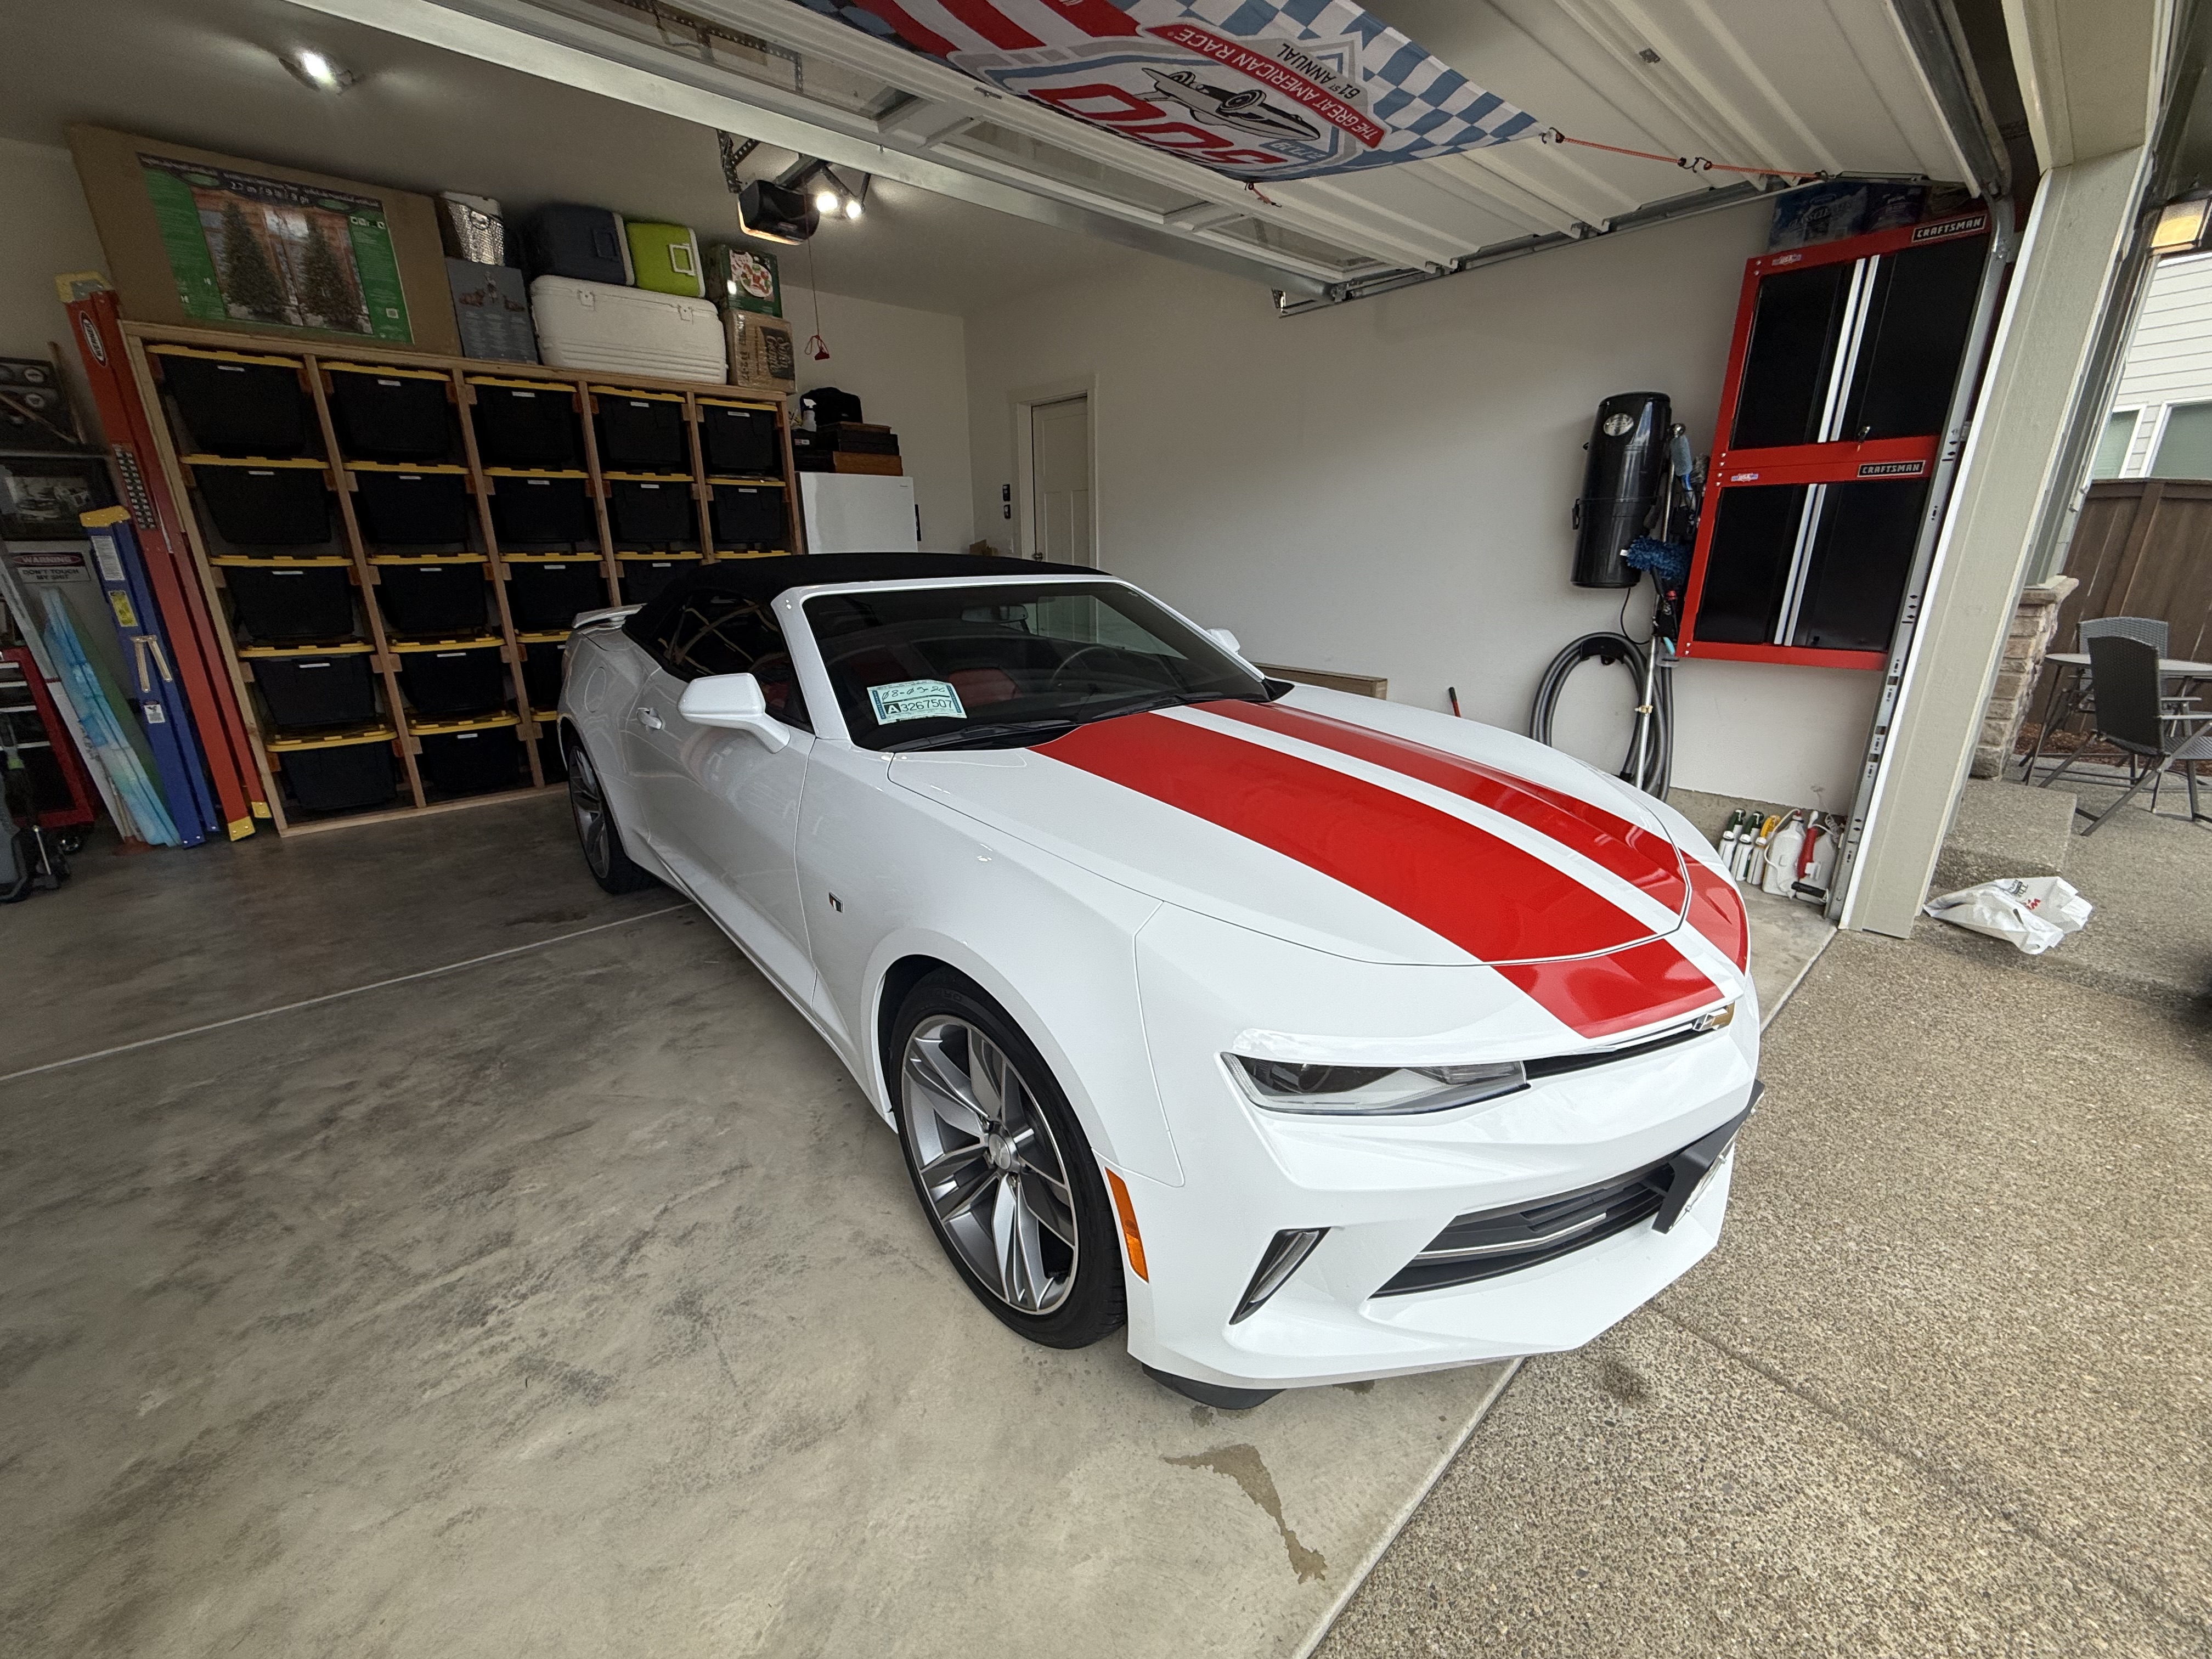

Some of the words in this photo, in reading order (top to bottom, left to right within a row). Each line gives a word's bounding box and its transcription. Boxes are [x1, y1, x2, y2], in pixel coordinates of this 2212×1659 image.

[1277, 43, 1336, 84] ANNUAL
[1233, 59, 1318, 101] AMERICAN
[1314, 97, 1358, 127] GREAT
[1357, 125, 1378, 140] THE
[1917, 218, 1982, 238] CRAFTSMAN
[1862, 463, 1920, 474] CRAFTSMAN
